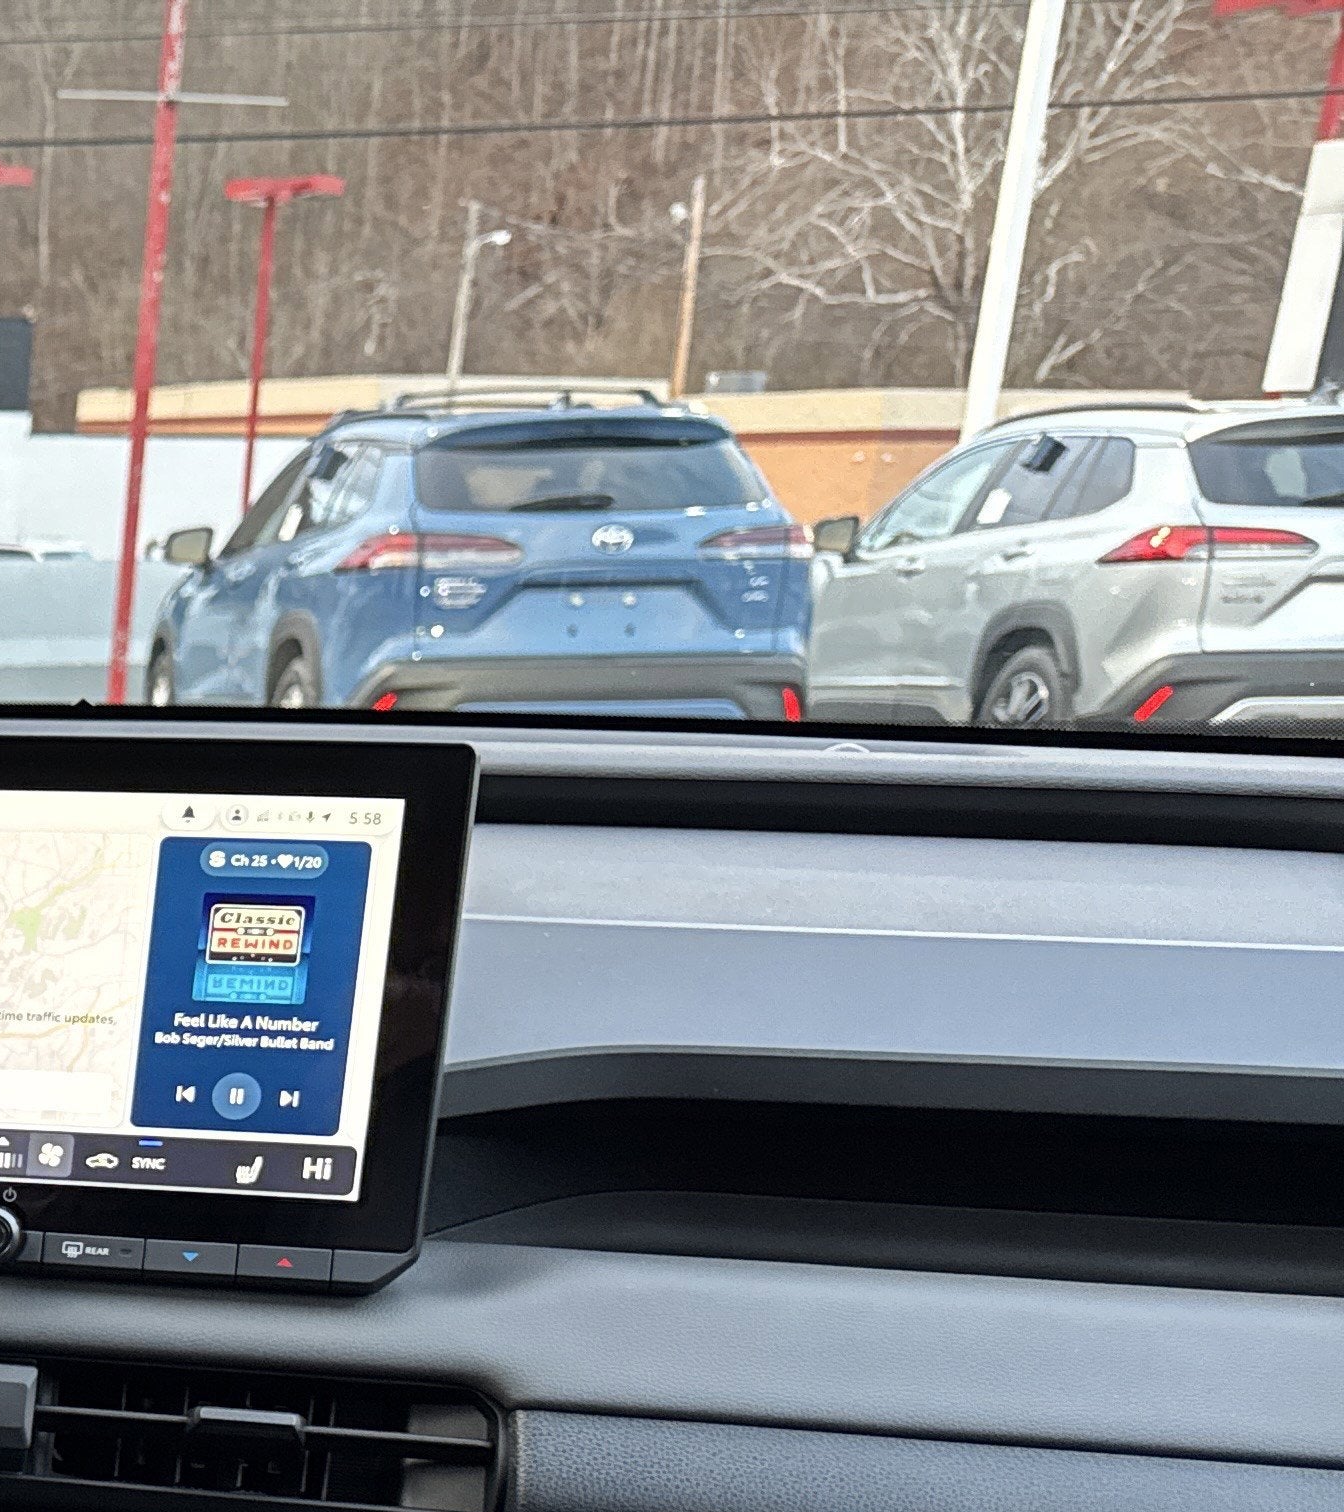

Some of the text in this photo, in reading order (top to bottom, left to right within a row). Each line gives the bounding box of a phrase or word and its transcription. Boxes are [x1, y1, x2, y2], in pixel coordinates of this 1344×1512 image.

[230, 854, 250, 867] Ch
[251, 854, 268, 868] 25
[220, 911, 296, 926] Classic
[217, 937, 293, 950] REWIND
[26, 1012, 61, 1023] traffic
[64, 1012, 118, 1026] updates,
[173, 1012, 319, 1033] Feel Like A Number
[154, 1031, 335, 1051] Bob Seger/Silver Bullet Band
[131, 1156, 166, 1171] SYNC
[301, 1156, 333, 1181] Hi
[84, 1246, 110, 1257] REAR
